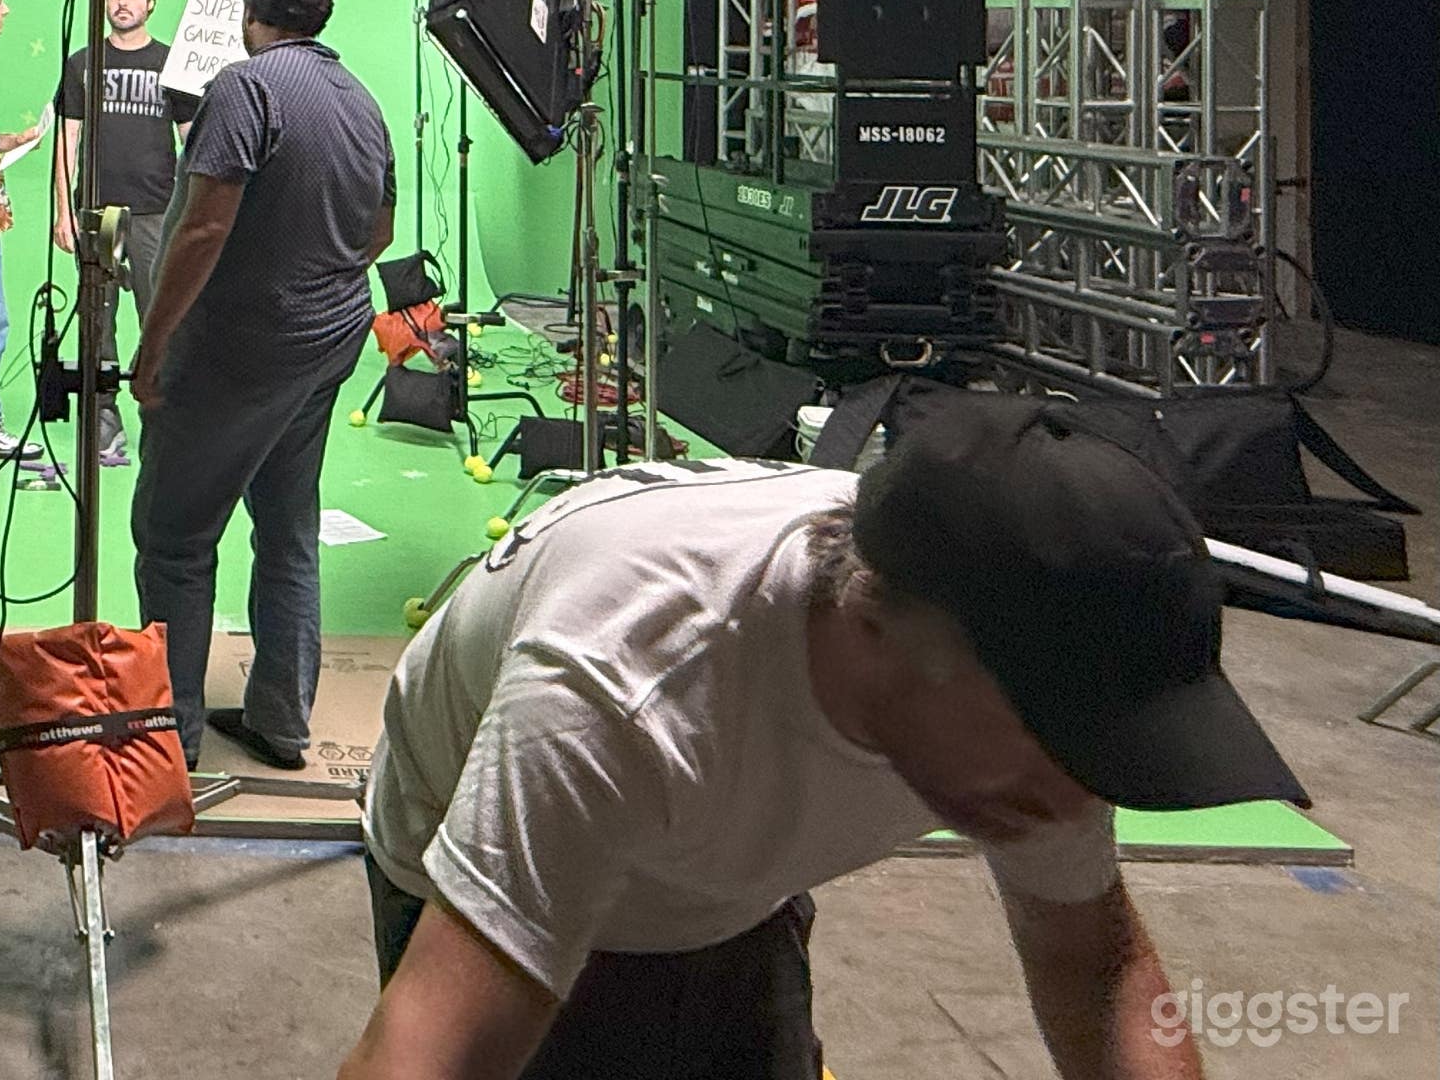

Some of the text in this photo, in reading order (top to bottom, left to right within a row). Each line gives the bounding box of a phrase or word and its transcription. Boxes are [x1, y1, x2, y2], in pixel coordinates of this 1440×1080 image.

[184, 24, 242, 49] GAVE M
[84, 67, 165, 105] STOR
[859, 125, 946, 143] MSS-18062
[861, 186, 958, 222] JLG
[327, 767, 371, 777] ARD
